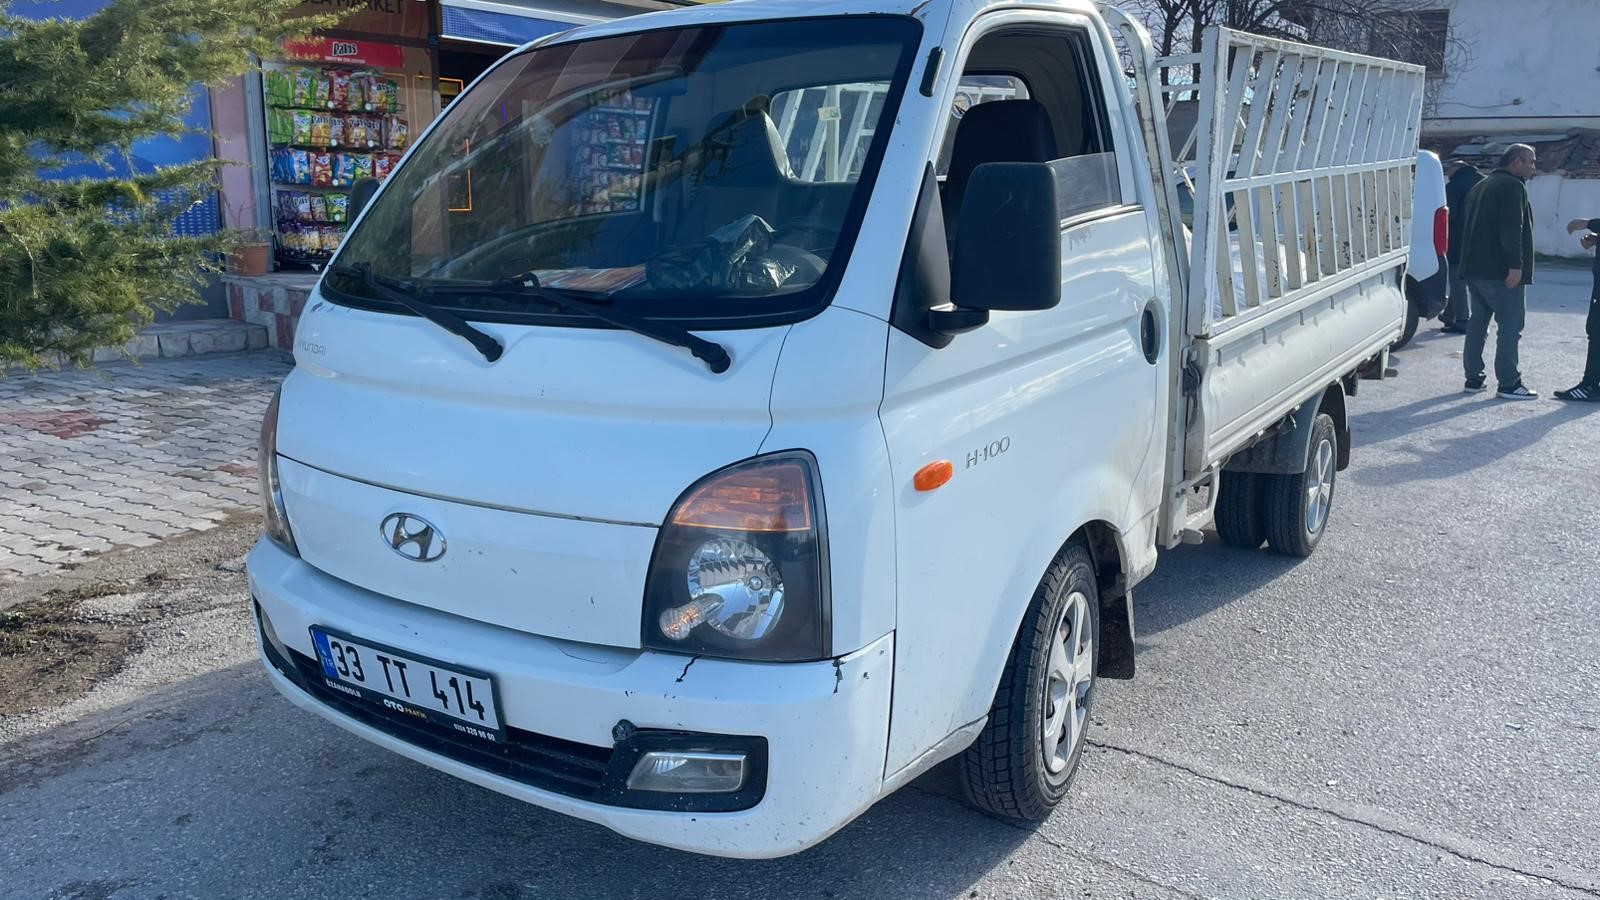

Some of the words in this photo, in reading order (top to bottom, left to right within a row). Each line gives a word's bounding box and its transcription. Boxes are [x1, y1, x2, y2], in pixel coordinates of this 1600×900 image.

[965, 436, 1011, 468] H-100
[330, 641, 365, 682] 33
[376, 654, 411, 698] TT
[429, 670, 485, 721] 414
[383, 698, 405, 713] OTO
